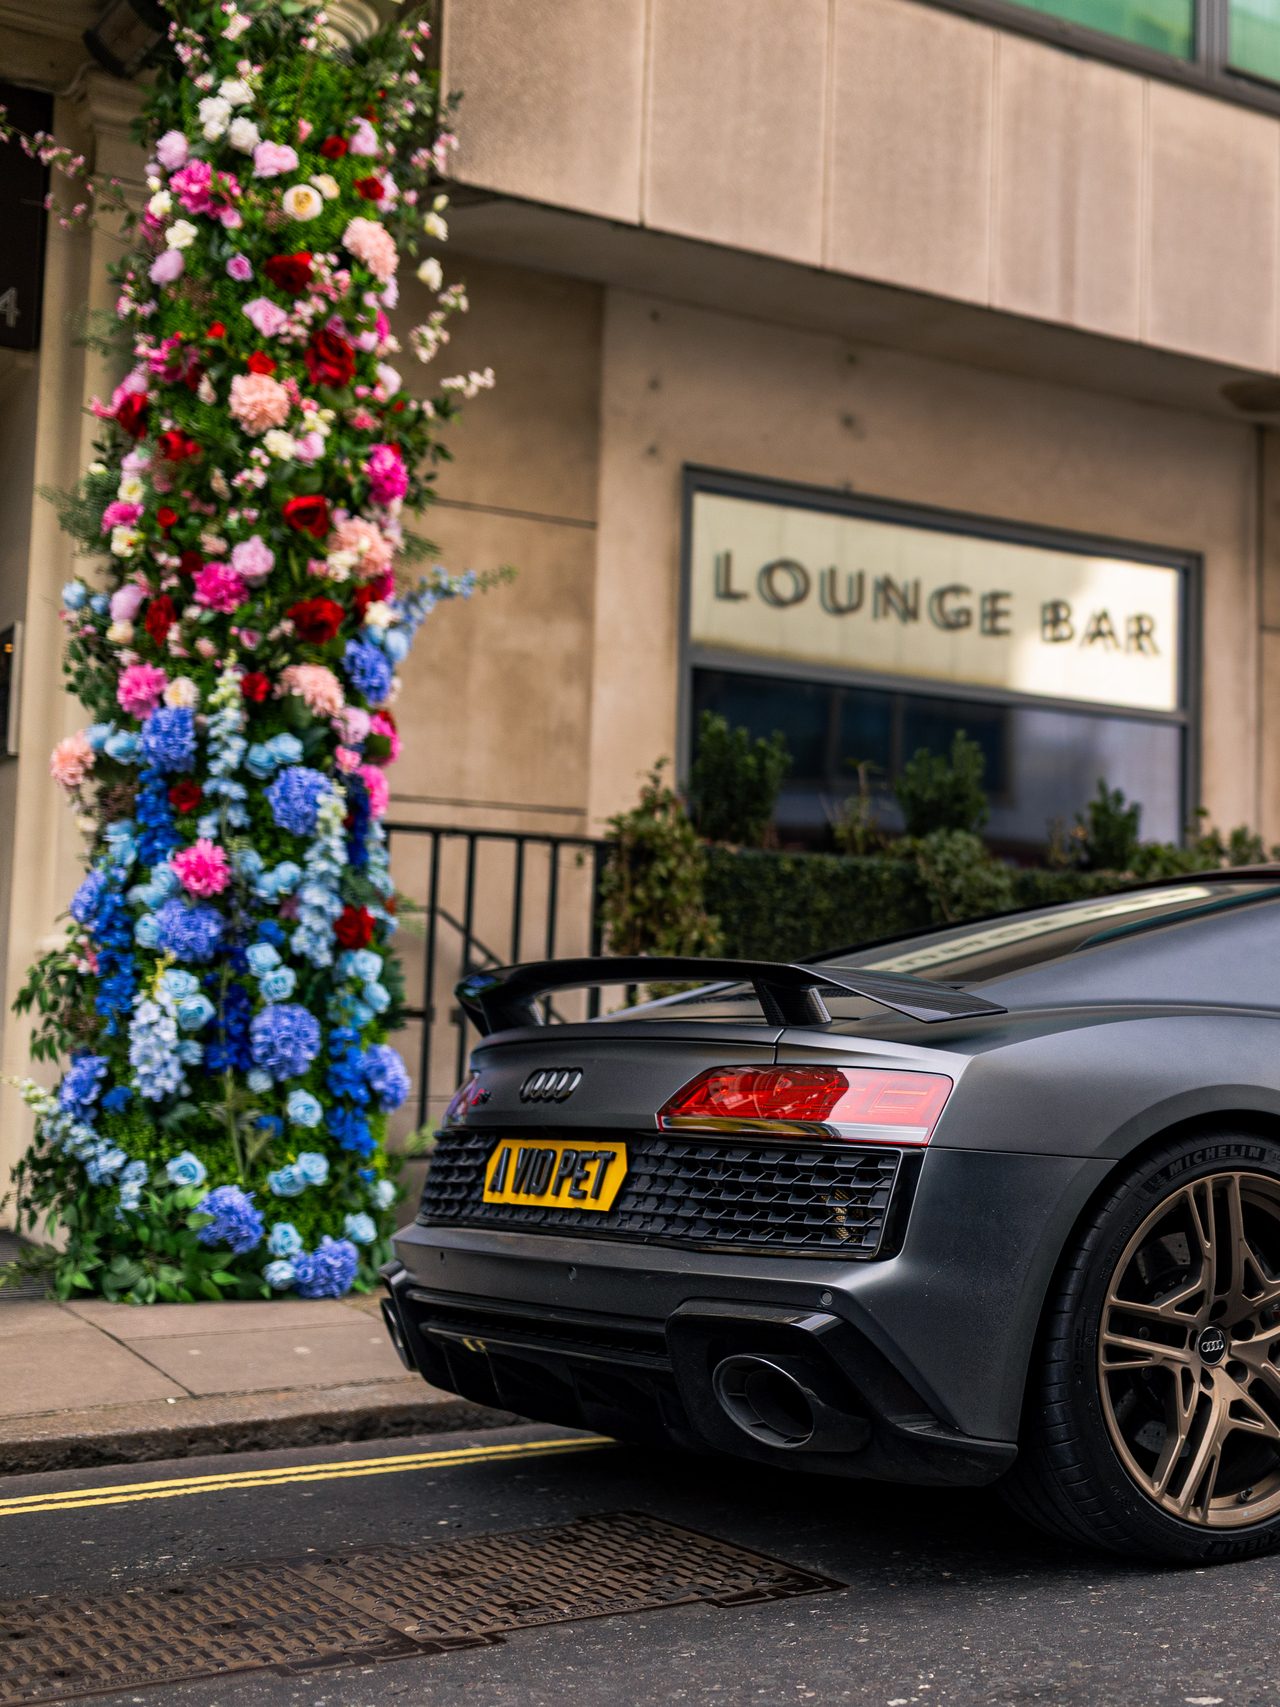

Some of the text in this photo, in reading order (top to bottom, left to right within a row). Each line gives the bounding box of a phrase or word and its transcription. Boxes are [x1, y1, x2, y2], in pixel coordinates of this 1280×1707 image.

[714, 550, 1160, 657] LOUNGE BAR
[1168, 1145, 1261, 1177] MICHELIN
